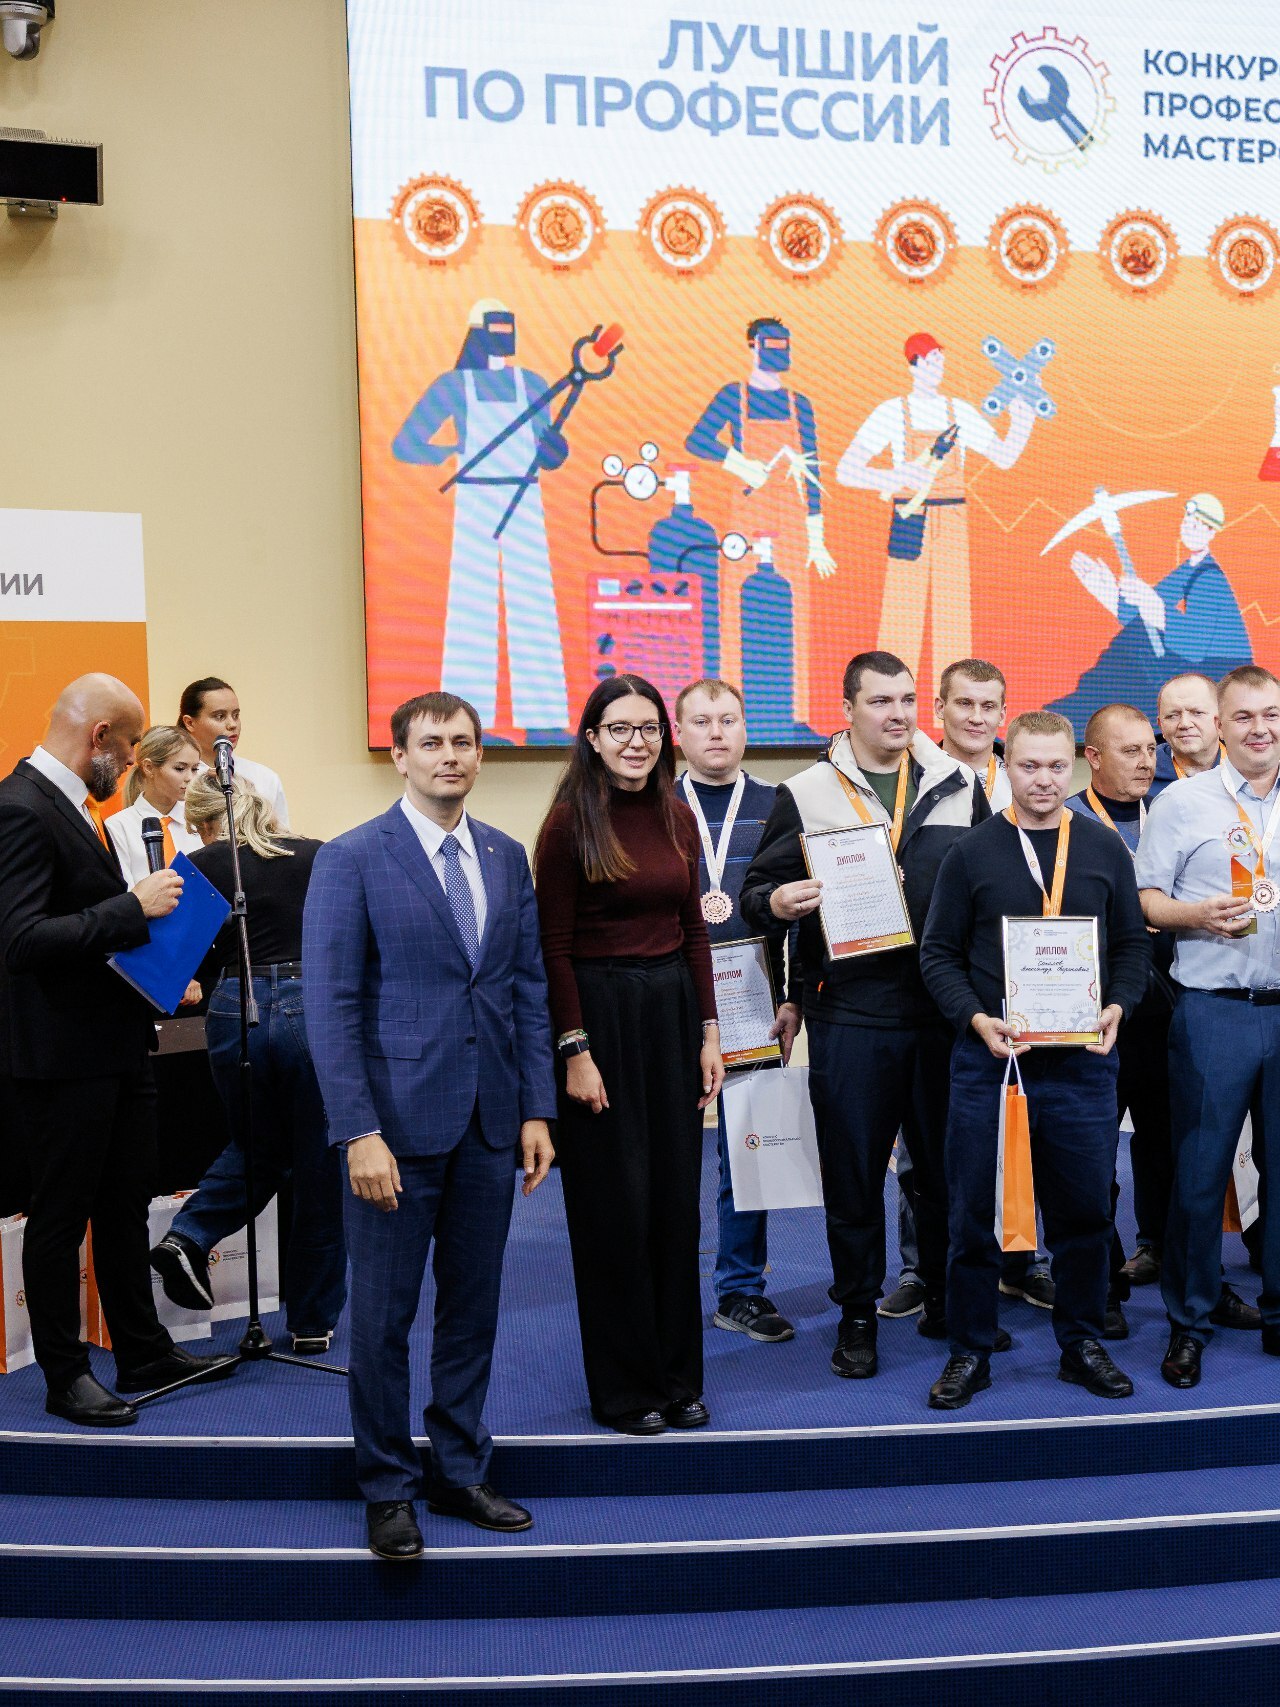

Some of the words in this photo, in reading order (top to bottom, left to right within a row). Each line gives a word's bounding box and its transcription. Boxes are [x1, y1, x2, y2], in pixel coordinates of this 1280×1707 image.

[659, 19, 950, 86] ЛУЧШИЙ
[423, 66, 525, 123] ПО
[545, 73, 951, 147] ПРОФЕССИИ
[1035, 946, 1068, 956] ДИПЛОМ
